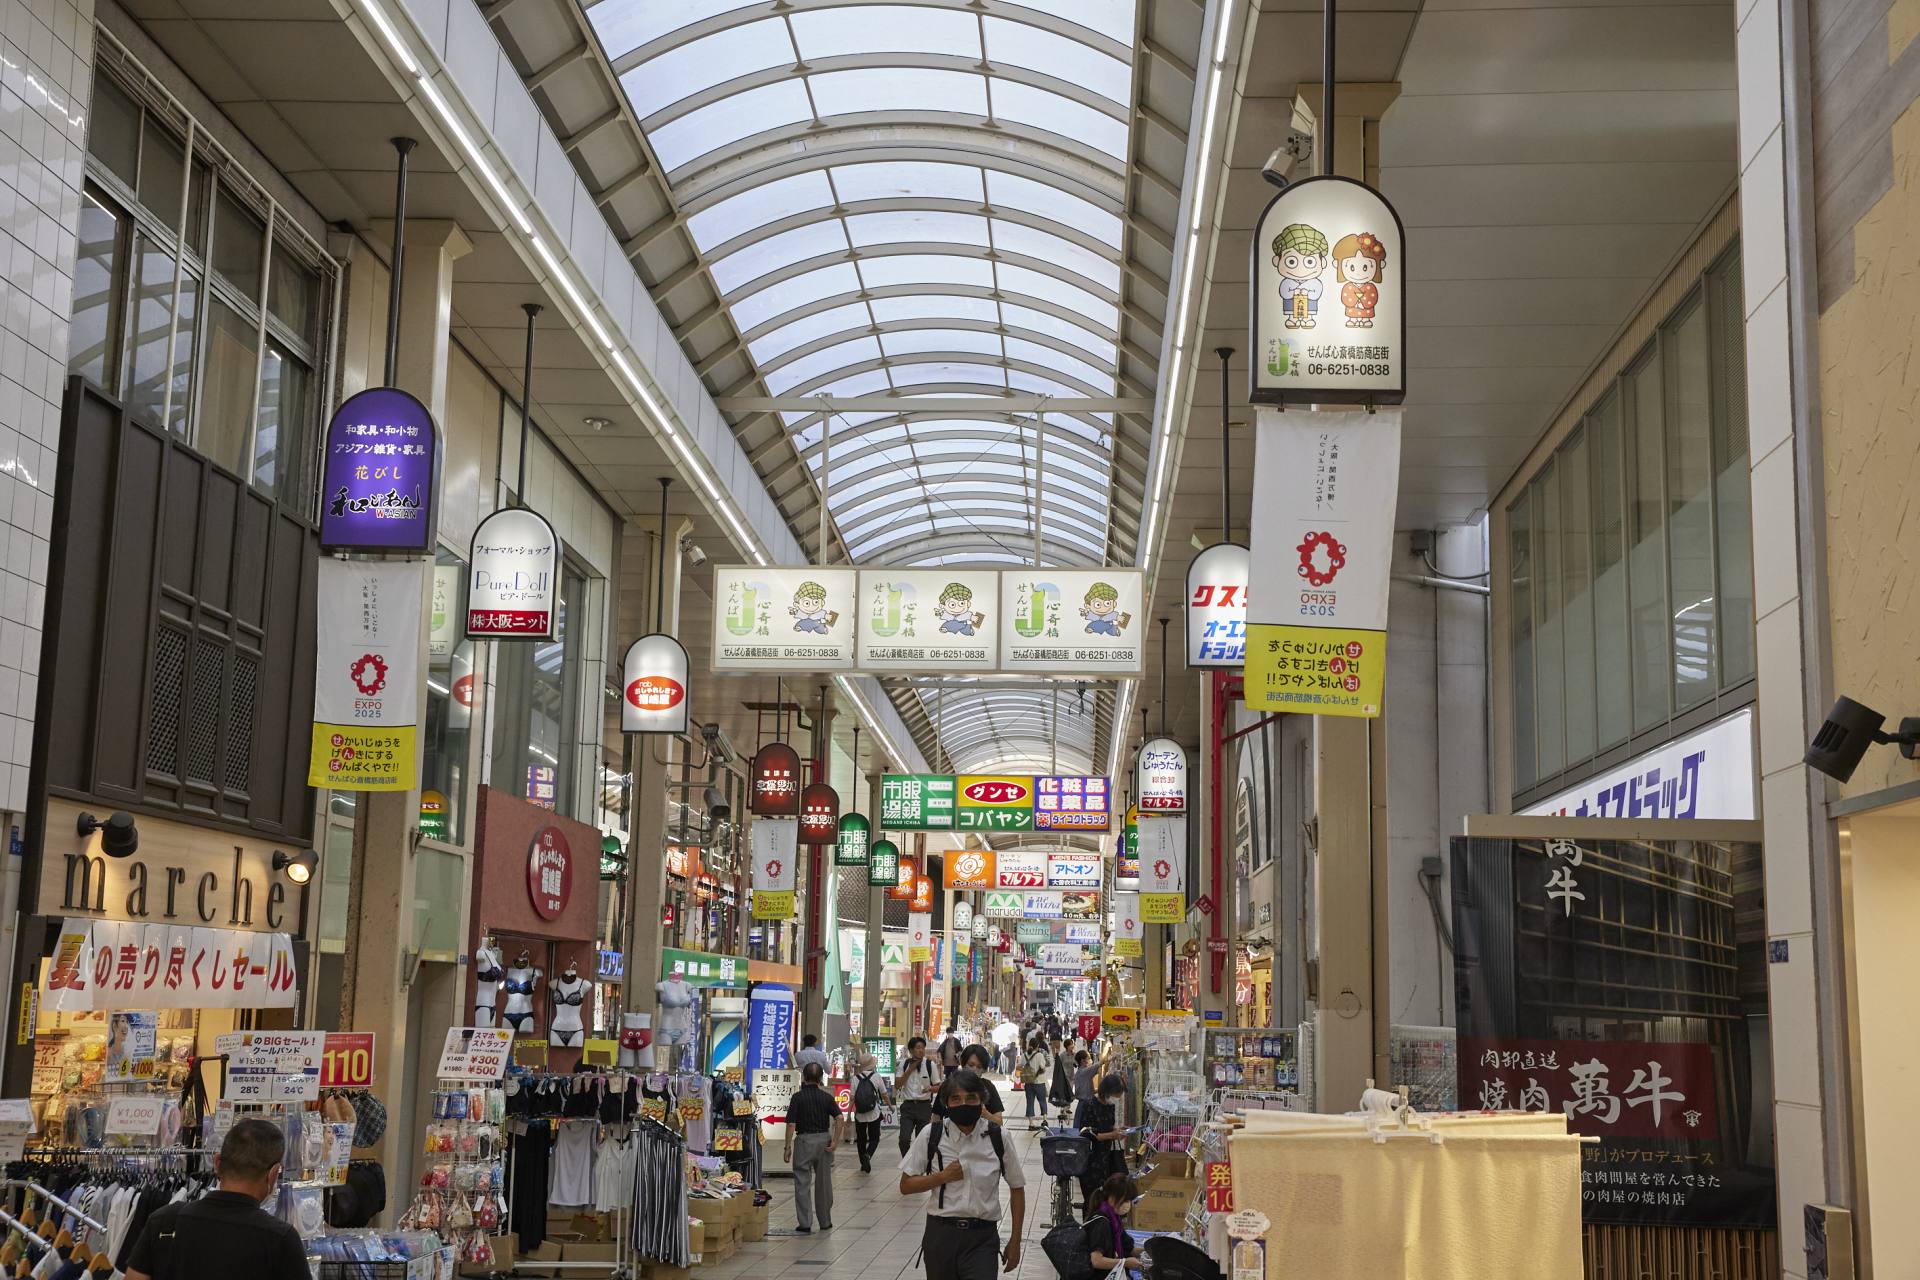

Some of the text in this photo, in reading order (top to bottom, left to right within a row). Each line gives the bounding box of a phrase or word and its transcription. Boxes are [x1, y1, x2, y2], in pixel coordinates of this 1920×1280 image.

[1307, 346, 1389, 360] せんば心斎橋筋商店街
[1308, 363, 1390, 376] 06-6251-0838
[335, 443, 425, 455] アジアン雑貨・家具
[476, 545, 551, 555] フォーマル・ショップ
[475, 570, 547, 591] Pure Doll
[728, 581, 740, 615] せんば
[873, 582, 885, 616] せんば
[1017, 582, 1029, 617] せんば
[784, 648, 839, 658] 06-6251-0838
[930, 649, 986, 659] 06-6251-0838
[1075, 650, 1134, 660] 06-6251-0838
[354, 701, 382, 710] EXPO
[354, 709, 382, 718] 2025
[332, 735, 400, 747] せかいじゅうを
[331, 747, 393, 760] げんきにする
[1147, 751, 1179, 760] カーテン
[1143, 761, 1183, 770] じゅうたん
[1039, 778, 1105, 793] 化粧品
[973, 786, 1018, 800] グンゼ
[1039, 795, 1105, 810] 医薬品
[1143, 797, 1183, 808] マルクラ
[960, 809, 1031, 828] コバヤシ
[1055, 864, 1094, 875] アドオン
[1000, 873, 1043, 886] マルクラ
[60, 846, 285, 928] marche
[48, 934, 294, 992] 夏の売り尽くしセール
[475, 1031, 496, 1039] スマホ
[472, 1040, 508, 1048] ストラップ
[253, 1047, 301, 1055] クールバンド
[322, 1048, 369, 1082] 110
[470, 1055, 500, 1066] ¥300
[1480, 1048, 1561, 1071] 肉卸直送
[467, 1065, 497, 1076] ¥500
[1479, 1057, 1686, 1129] 焼肉 萬牛
[1581, 1169, 1721, 1188] 食肉問屋を営んできた
[1582, 1189, 1686, 1206] の肉屋の焼肉店
